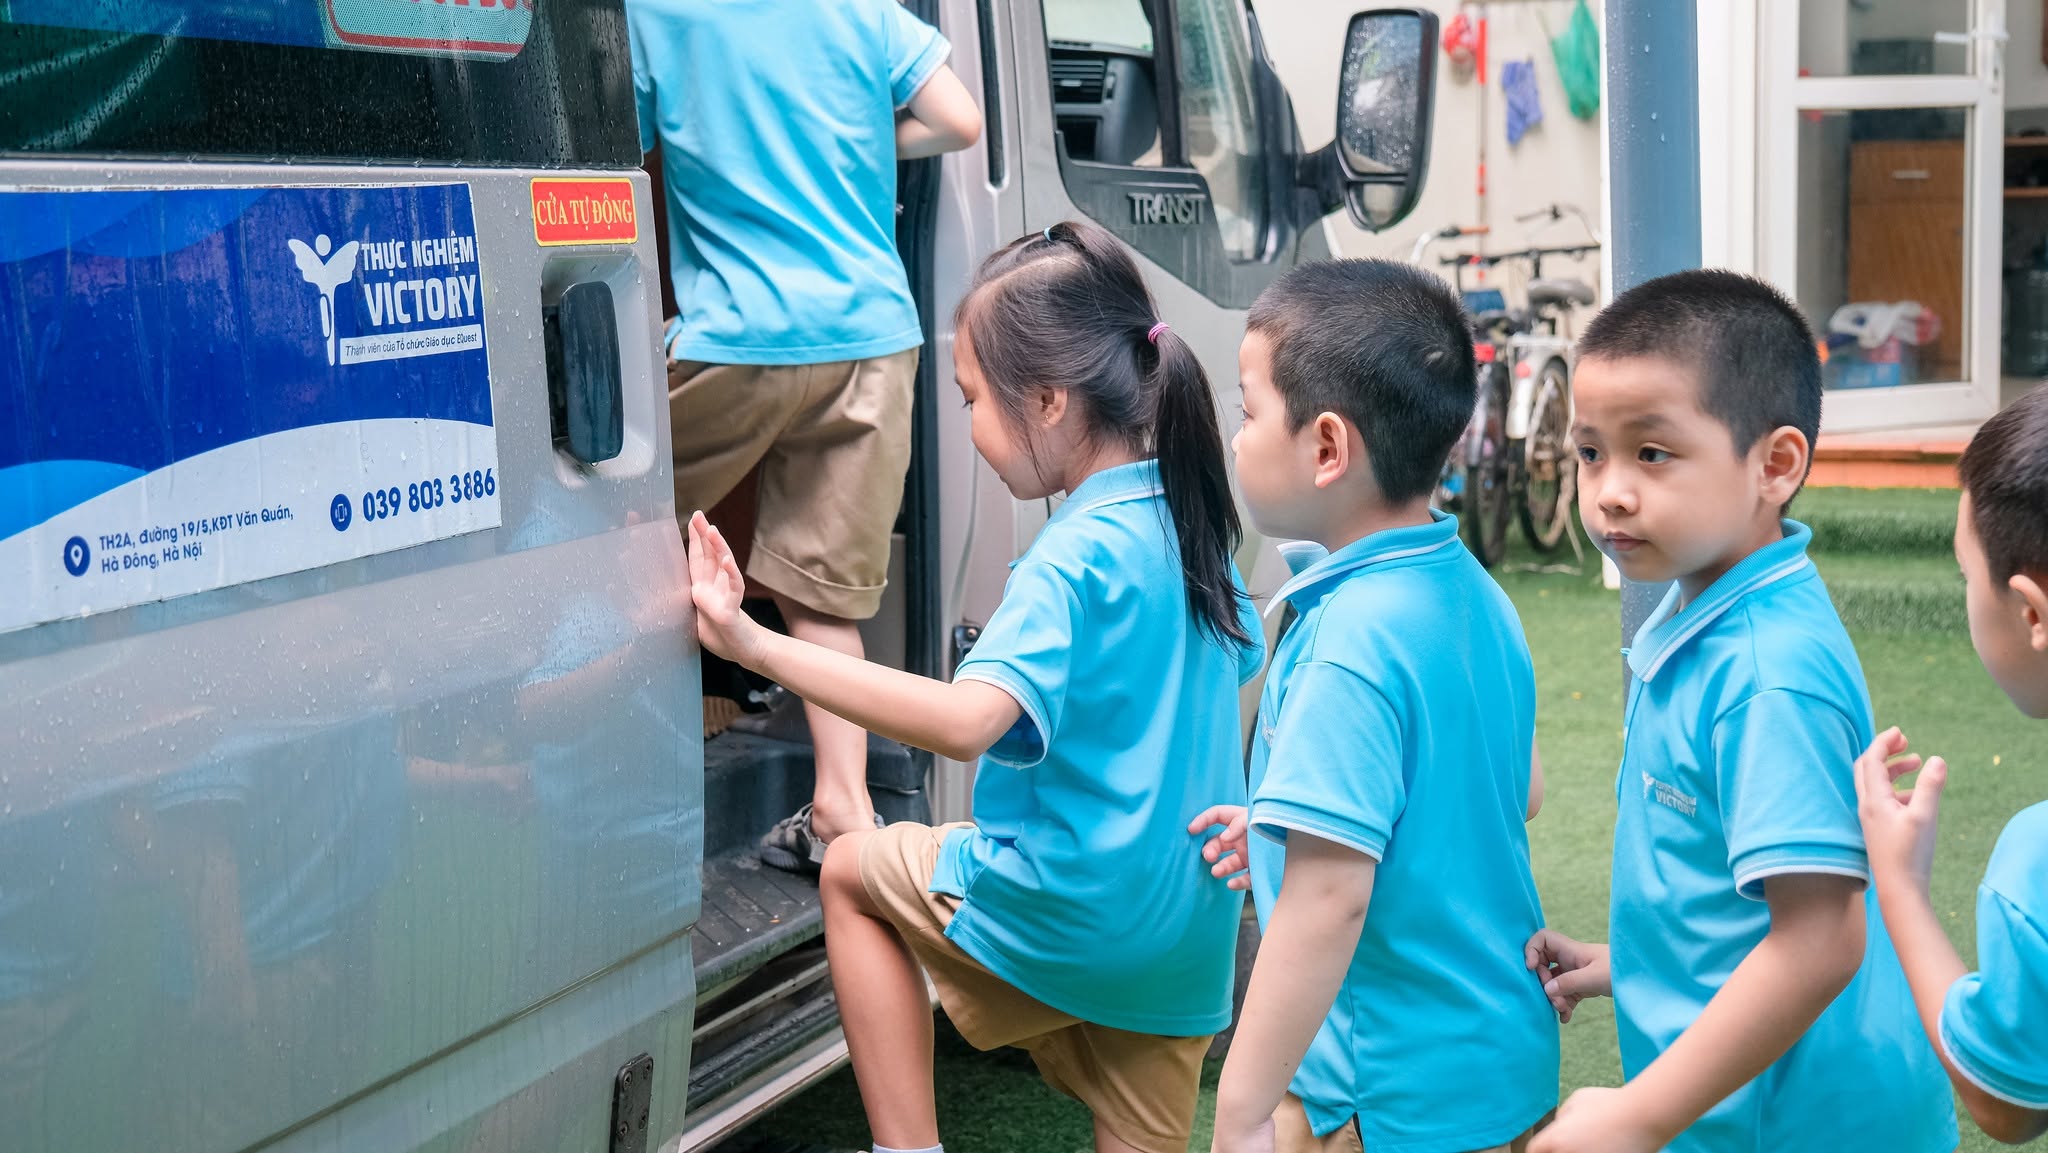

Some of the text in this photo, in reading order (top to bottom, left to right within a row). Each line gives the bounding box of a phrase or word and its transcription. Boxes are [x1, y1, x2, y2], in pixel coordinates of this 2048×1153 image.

[536, 192, 632, 231] CỬA TỰ ĐỘNG
[1126, 191, 1206, 225] TRANSIT
[361, 230, 475, 277] THỰC NGHIỆM
[364, 274, 476, 327] VICTORY
[382, 340, 396, 352] của
[396, 337, 405, 351] Tổ
[406, 338, 425, 350] chức
[425, 335, 440, 348] Giáo
[441, 335, 455, 348] dục
[456, 331, 477, 344] EQuest
[362, 467, 496, 522] 039 803 3886
[99, 532, 136, 551] TH2A,
[139, 525, 178, 543] đường
[236, 511, 258, 528] Văn
[261, 504, 294, 521] Quán,
[101, 541, 203, 573] Hà Đông, Hà Nội
[1655, 790, 1696, 819] VICTORY
